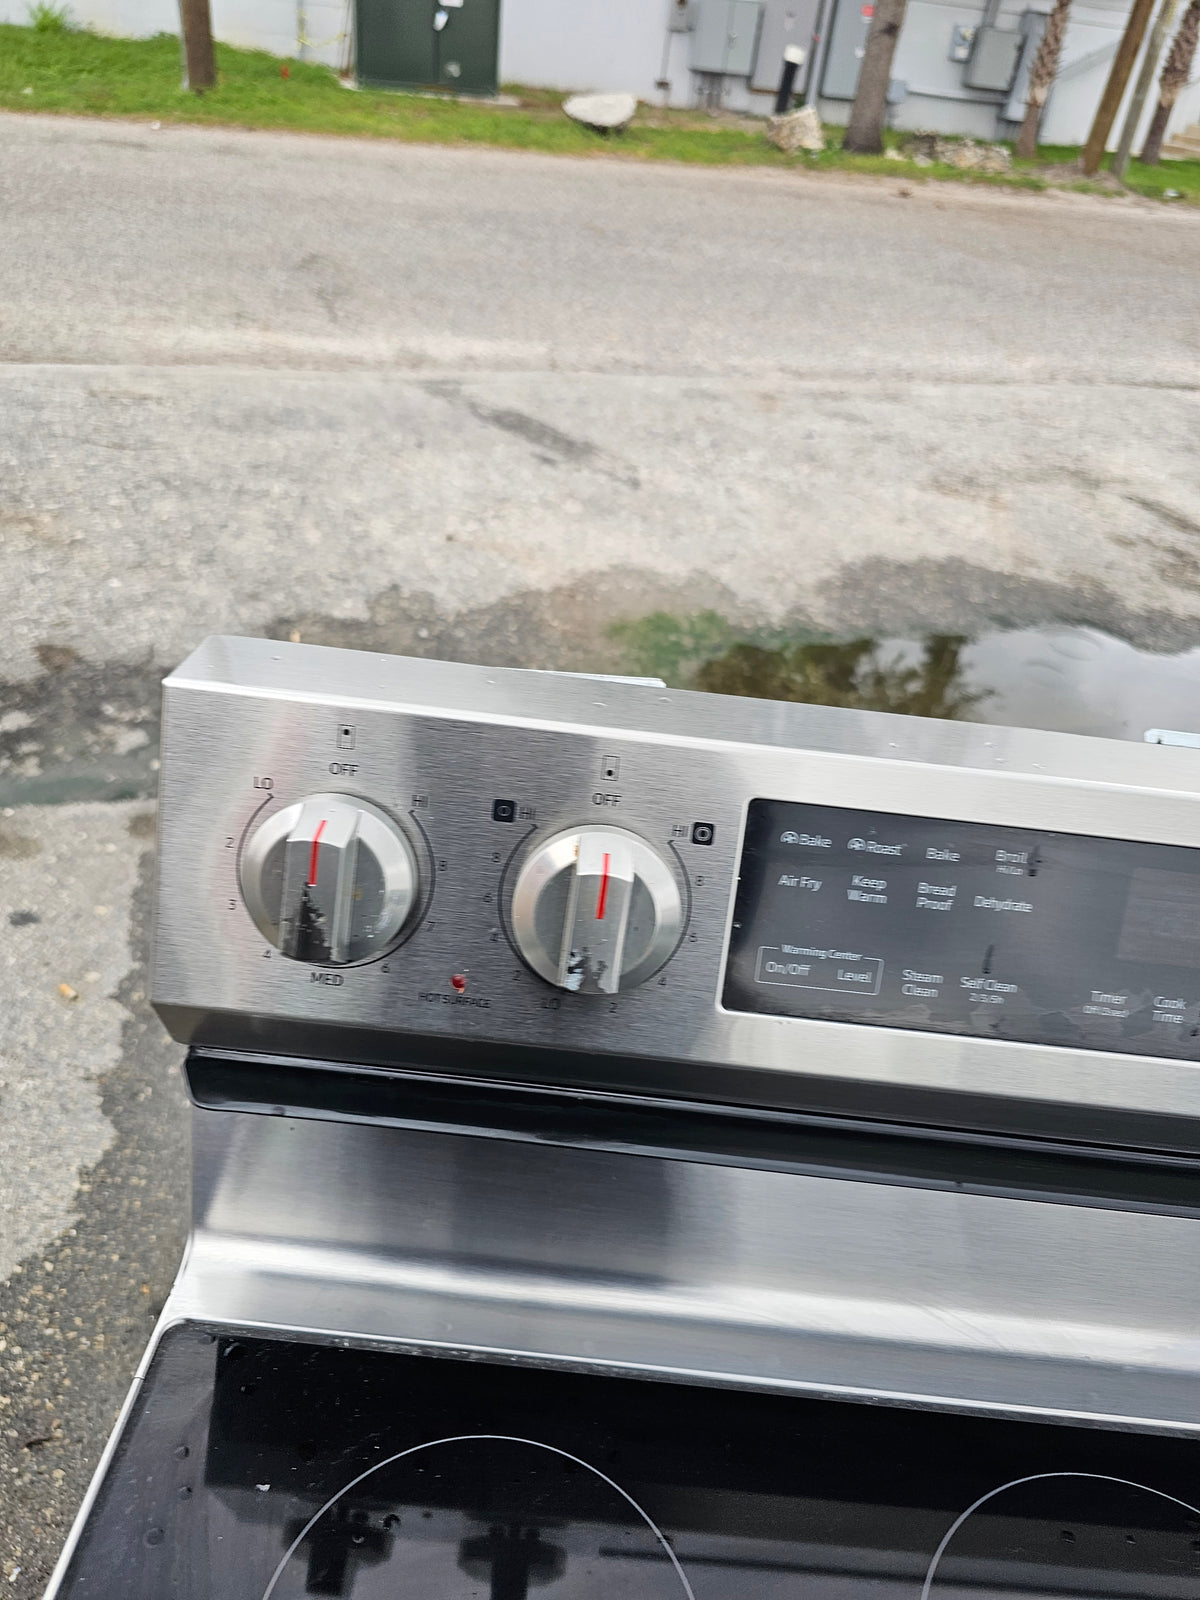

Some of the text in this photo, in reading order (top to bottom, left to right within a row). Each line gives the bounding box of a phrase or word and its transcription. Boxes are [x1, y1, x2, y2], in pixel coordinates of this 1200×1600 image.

[328, 762, 360, 776] OFF
[253, 776, 274, 790] LO
[591, 792, 623, 807] OFF
[225, 836, 235, 849] 2
[798, 833, 833, 848] Bake
[864, 841, 903, 856] Roast
[925, 847, 960, 862] Bake
[995, 849, 1028, 864] Broil
[777, 874, 823, 892] Air Fry
[851, 875, 887, 891] Keep
[917, 882, 957, 897] Bread
[847, 889, 888, 904] Warm
[915, 897, 954, 911] Proof
[973, 896, 1034, 913] Dehydrate
[781, 944, 863, 961] Warming Center
[765, 961, 812, 977] On/Off
[837, 969, 872, 983] Level
[901, 969, 944, 984] Steam
[310, 971, 345, 987] MED
[960, 976, 1018, 993] Self Clean
[901, 983, 939, 998] Clean
[1090, 990, 1128, 1005] Timer
[418, 991, 492, 1008] HOT SURFACE
[1153, 996, 1187, 1010] Cook
[1152, 1010, 1184, 1024] Time
